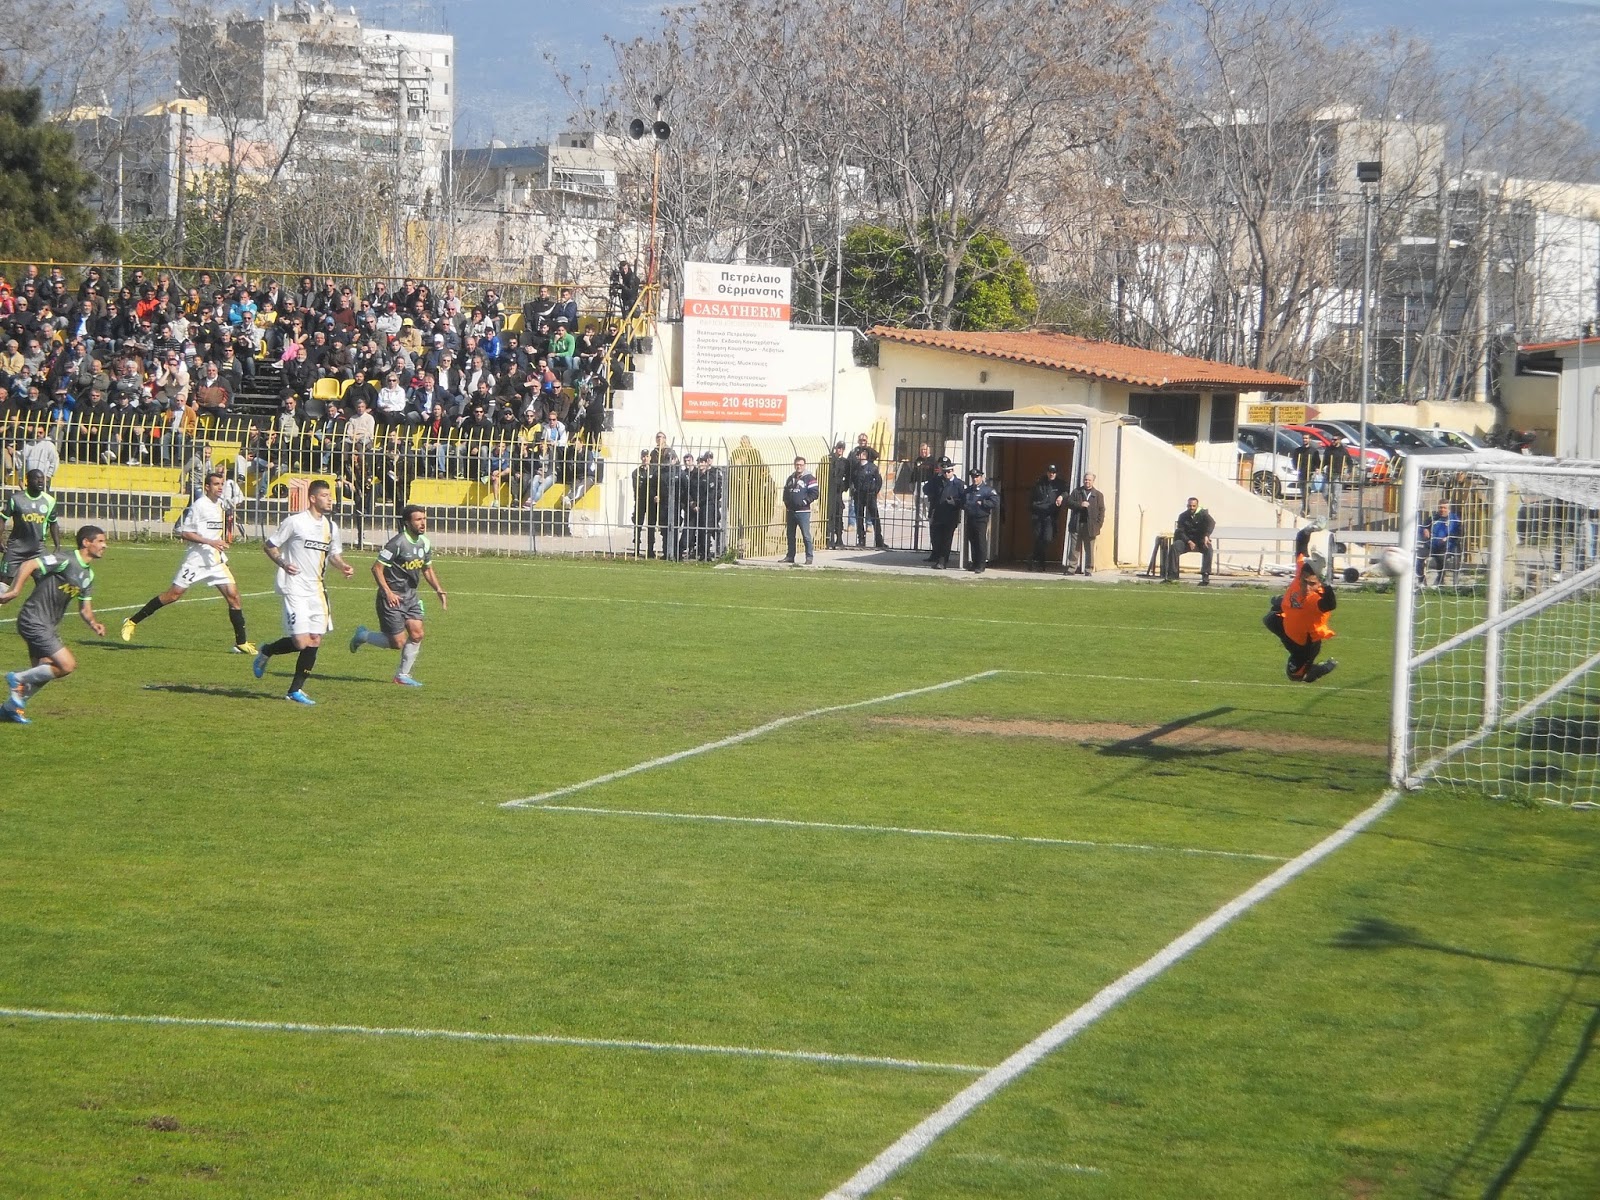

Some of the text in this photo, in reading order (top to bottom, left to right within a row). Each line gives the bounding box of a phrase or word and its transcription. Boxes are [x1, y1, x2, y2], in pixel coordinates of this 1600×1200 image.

[721, 271, 781, 284] Πετρέλαιο
[717, 284, 784, 299] Θέρμανσης
[692, 303, 782, 318] CASATHERM
[722, 397, 739, 408] 210
[742, 397, 783, 409] 4819387
[182, 569, 196, 582] 22
